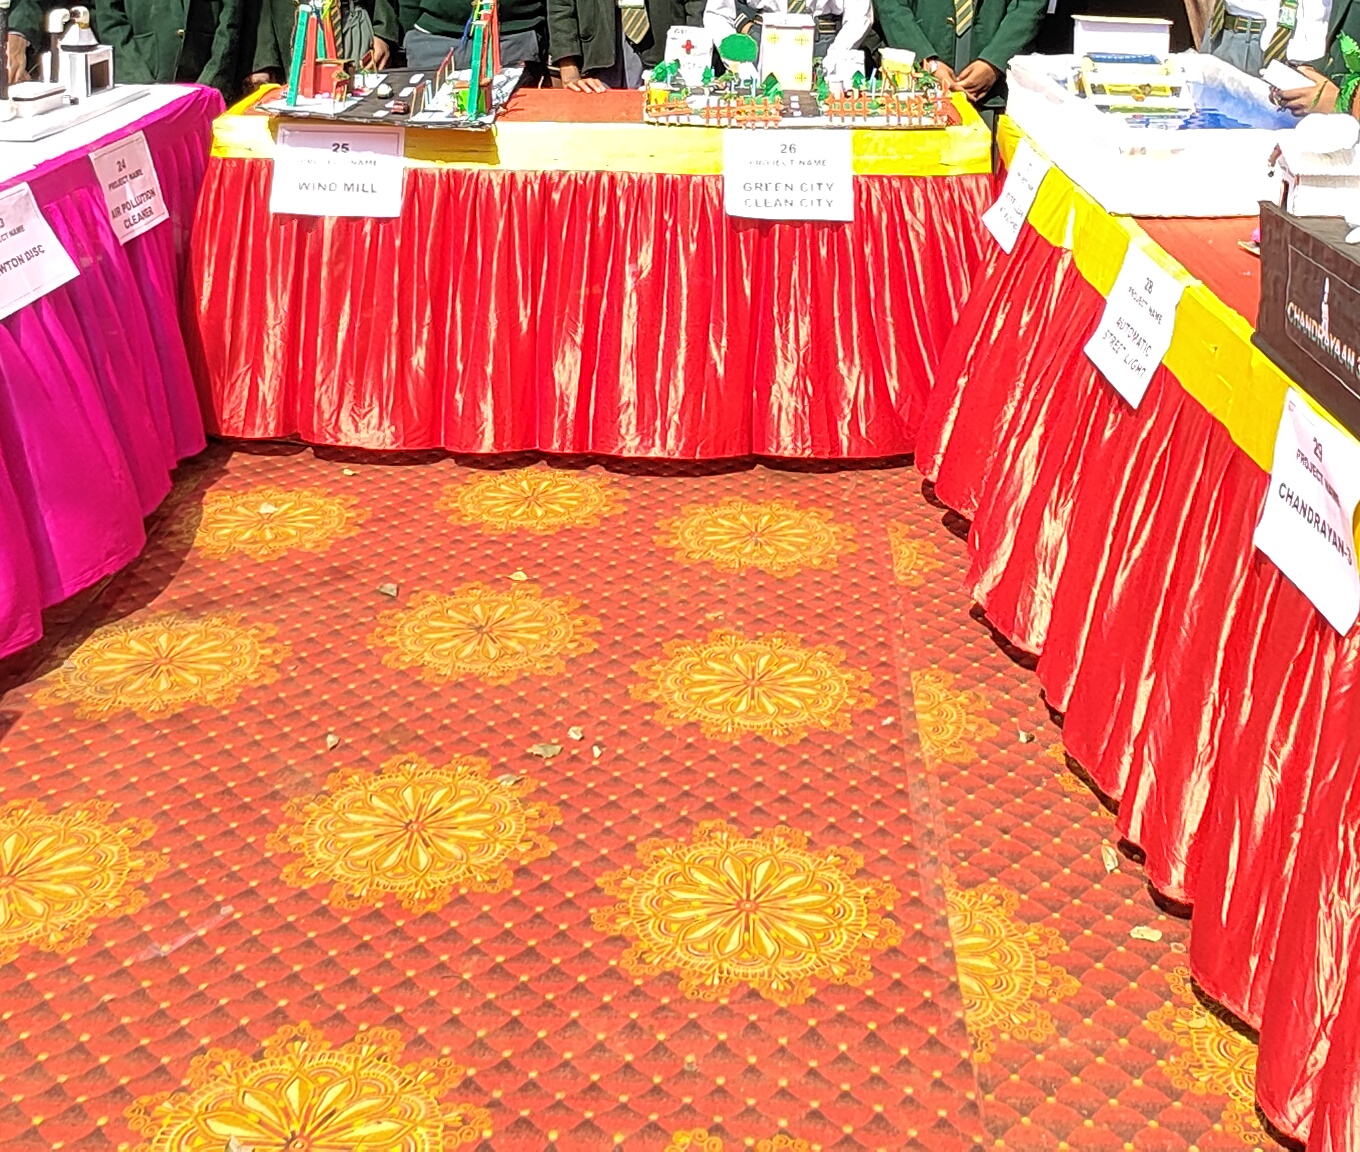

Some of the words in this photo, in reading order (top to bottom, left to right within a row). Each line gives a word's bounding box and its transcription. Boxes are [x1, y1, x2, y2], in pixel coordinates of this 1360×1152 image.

[332, 142, 350, 154] 25
[780, 143, 797, 154] 26
[116, 159, 126, 172] 24
[298, 182, 338, 192] WIND
[343, 182, 378, 194] MILL
[800, 182, 835, 193] CITY
[799, 198, 834, 208] CITY
[123, 206, 155, 230] CLEANER
[9, 224, 26, 238] NAME
[25, 244, 45, 262] DISC
[1116, 316, 1152, 357] AUTOMATIC
[1123, 354, 1147, 379] LIGHT
[1296, 448, 1324, 486] PROJECT
